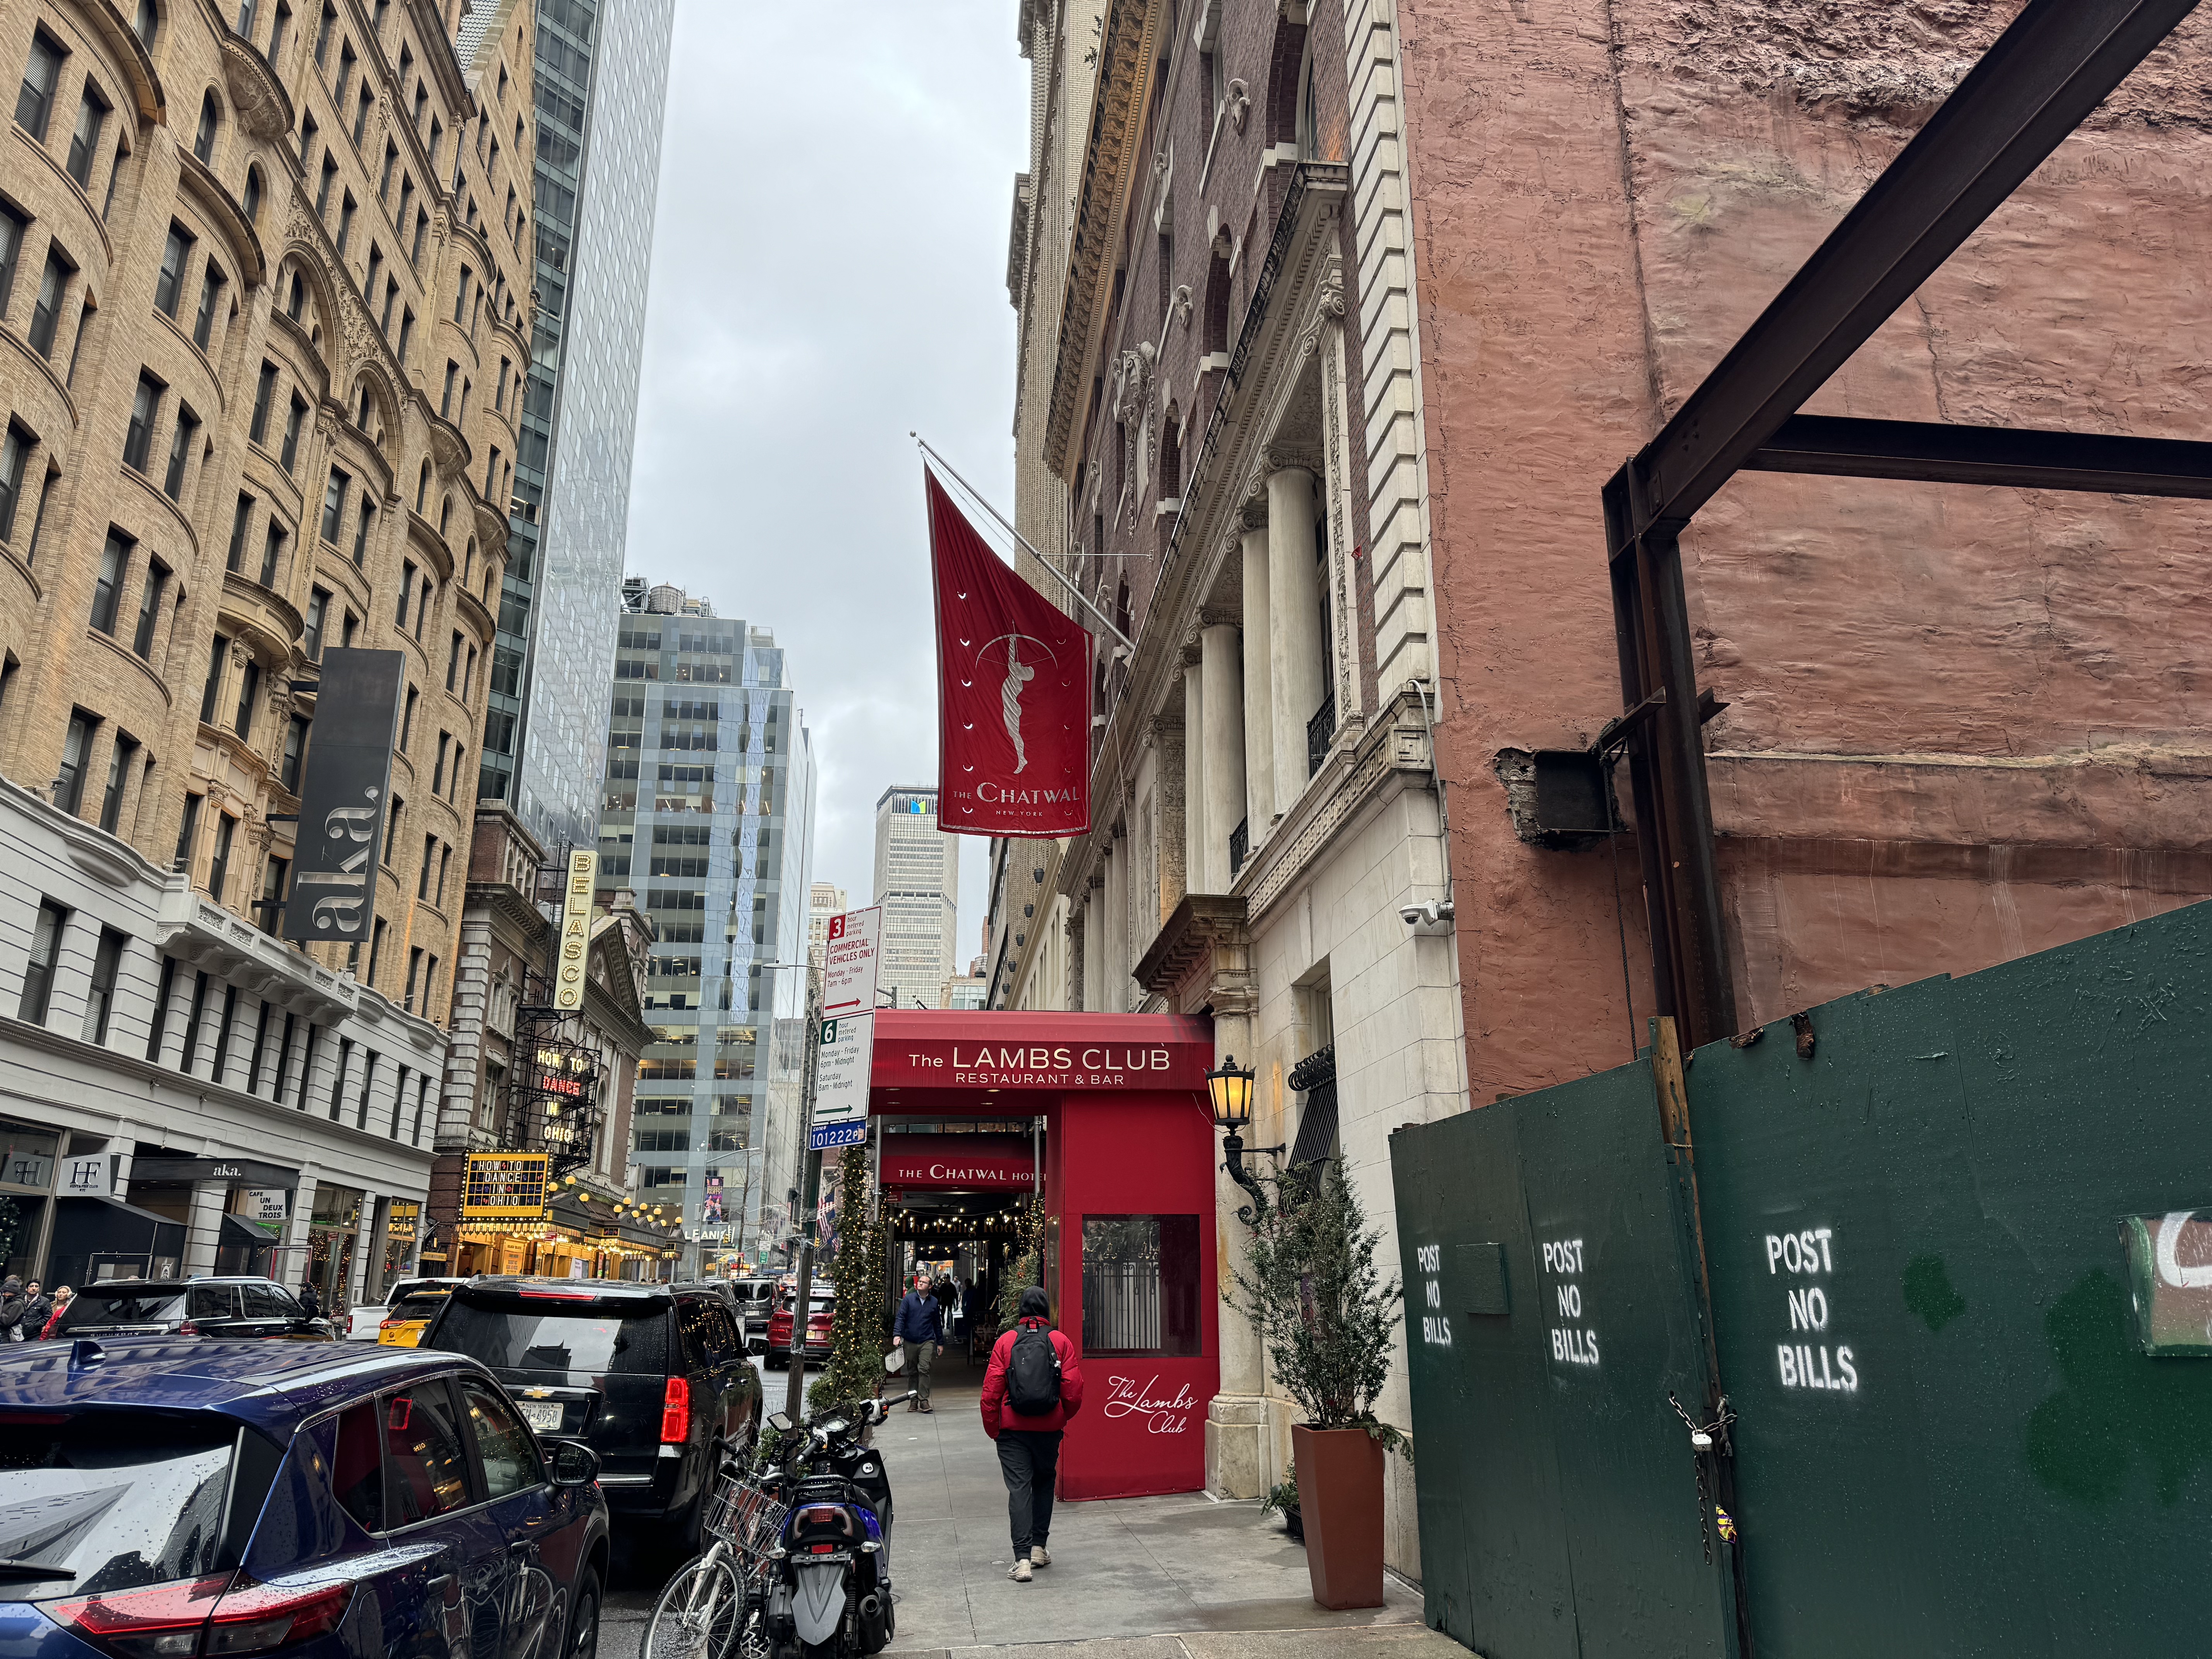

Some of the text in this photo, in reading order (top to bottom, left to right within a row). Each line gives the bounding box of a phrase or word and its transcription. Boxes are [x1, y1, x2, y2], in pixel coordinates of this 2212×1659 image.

[953, 782, 1080, 804] THE CHATWAL
[296, 786, 378, 932] aka.
[559, 855, 591, 1005] BELASCO
[833, 918, 842, 937] 3
[846, 929, 862, 937] parking
[847, 920, 864, 929] metered
[830, 938, 869, 954] COMMERCIAL
[830, 948, 875, 965] VEHICLES ONLY
[828, 969, 845, 978] Monday
[849, 966, 863, 974] Friday
[824, 1022, 833, 1042] 6
[838, 1035, 854, 1043] parking
[839, 1027, 856, 1035] metered
[537, 1049, 583, 1072] HOW TO
[821, 1049, 840, 1058] Monday
[845, 1046, 859, 1054] Friday
[835, 1056, 854, 1065] Midnight
[908, 1047, 1170, 1070] The LAMBS CLUB
[543, 1075, 580, 1096] DANCE
[819, 1073, 841, 1082] Saturday
[833, 1080, 852, 1089] Midnight
[956, 1073, 1123, 1085] RESTAURANT & BAR
[546, 1101, 558, 1116] IN
[544, 1126, 572, 1142] OHIO
[812, 1129, 852, 1147] 101222
[70, 1162, 102, 1184] HF
[213, 1164, 241, 1176] aka.
[479, 1161, 522, 1171] HOW TO
[898, 1170, 922, 1178] THE
[930, 1164, 1006, 1180] CHATWAL
[485, 1172, 520, 1182] DANCE
[493, 1184, 505, 1194] IN
[490, 1195, 518, 1206] OHIO
[1417, 1245, 1440, 1273] POST
[1543, 1240, 1583, 1273] POST
[1766, 1229, 1832, 1274] POST
[1426, 1281, 1440, 1308] NO
[1557, 1285, 1581, 1317] NO
[1788, 1288, 1828, 1330] NO
[1423, 1317, 1451, 1346] BILLS
[1552, 1329, 1599, 1364] BILLS
[1778, 1345, 1858, 1391] BILLS
[1104, 1374, 1198, 1418] The Lambs
[1148, 1410, 1187, 1433] Club
